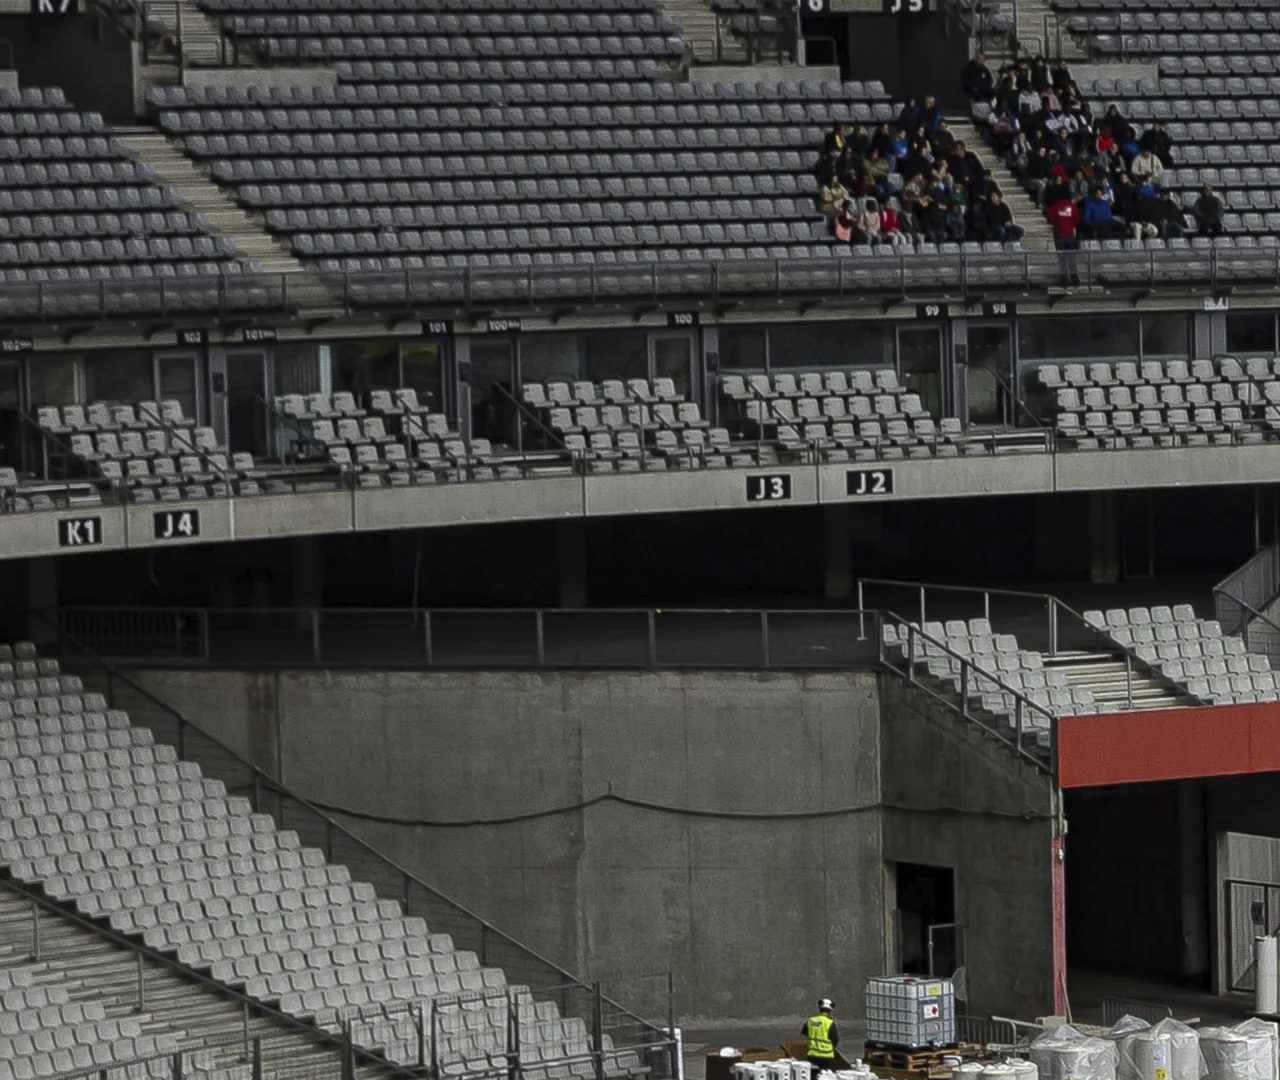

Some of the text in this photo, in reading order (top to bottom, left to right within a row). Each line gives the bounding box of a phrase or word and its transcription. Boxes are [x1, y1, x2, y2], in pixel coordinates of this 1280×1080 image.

[925, 305, 939, 316] 99
[756, 476, 784, 499] J3
[856, 471, 886, 494] J2
[67, 519, 95, 545] K1
[162, 512, 193, 538] J4
